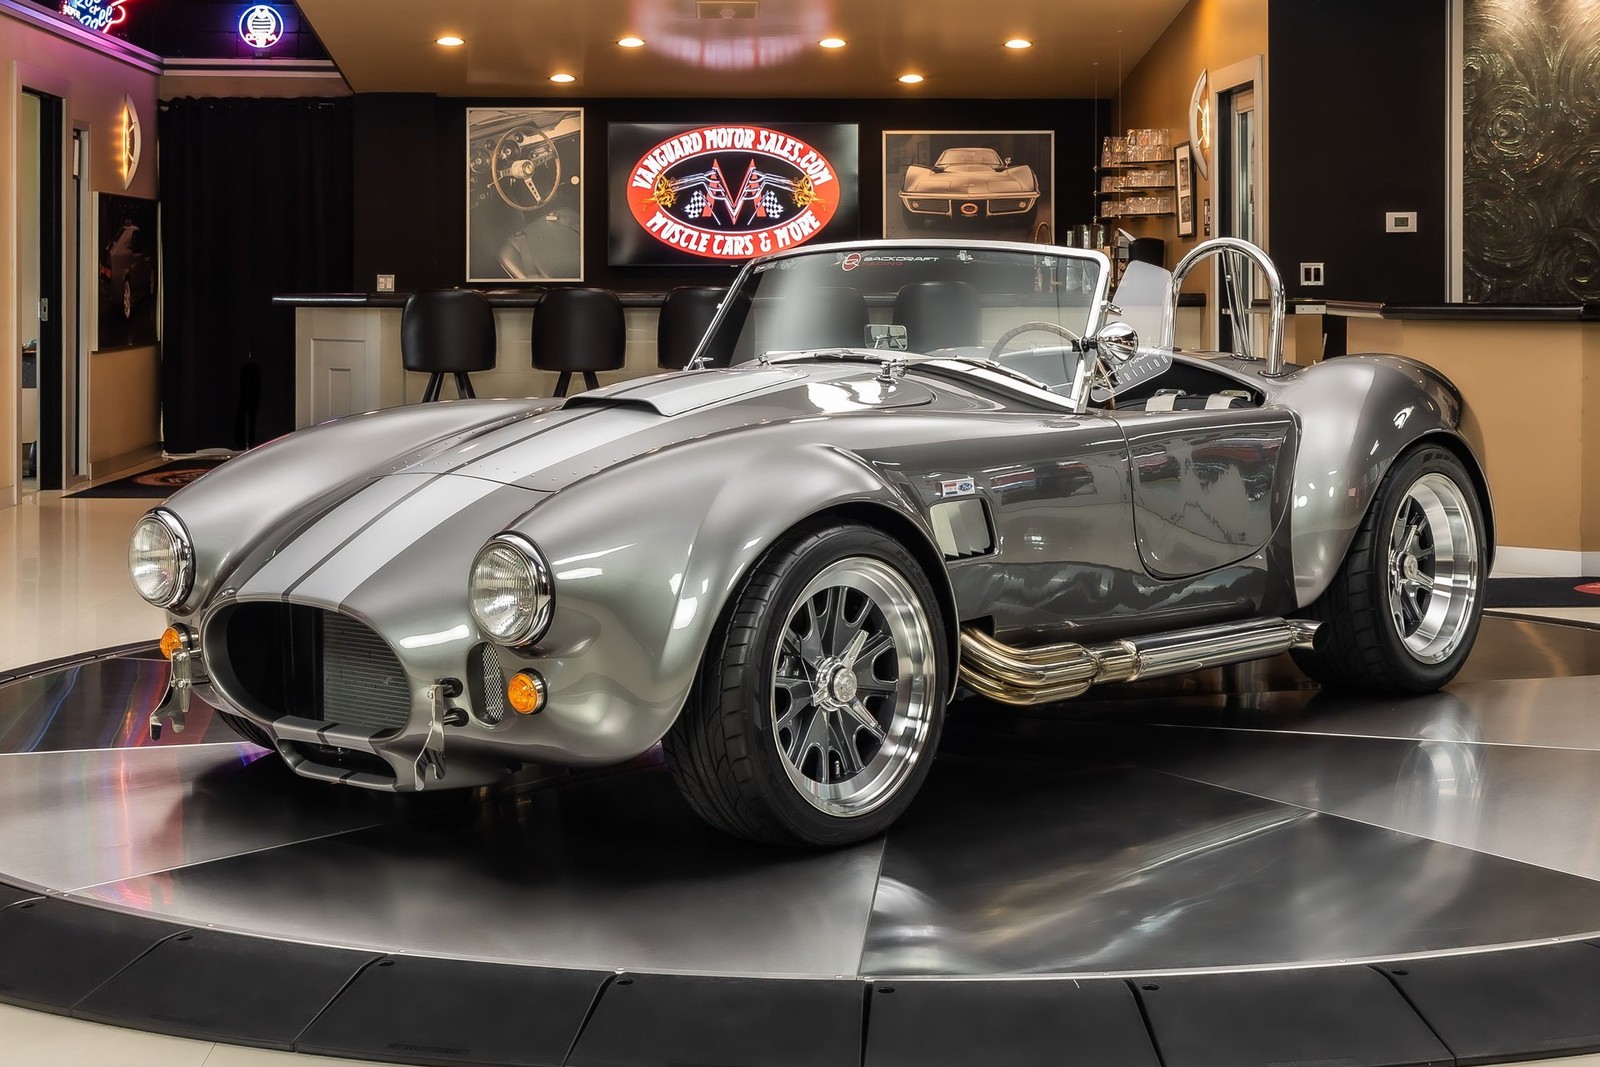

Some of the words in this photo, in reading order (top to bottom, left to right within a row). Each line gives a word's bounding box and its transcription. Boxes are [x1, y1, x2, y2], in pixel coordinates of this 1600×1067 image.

[632, 132, 702, 190] VANGUARD
[703, 128, 755, 150] MOTOR
[757, 129, 833, 186] SALES.COM
[646, 211, 710, 253] MUSCLE
[713, 235, 754, 256] CARS
[759, 233, 772, 253] &
[774, 210, 821, 248] MORE
